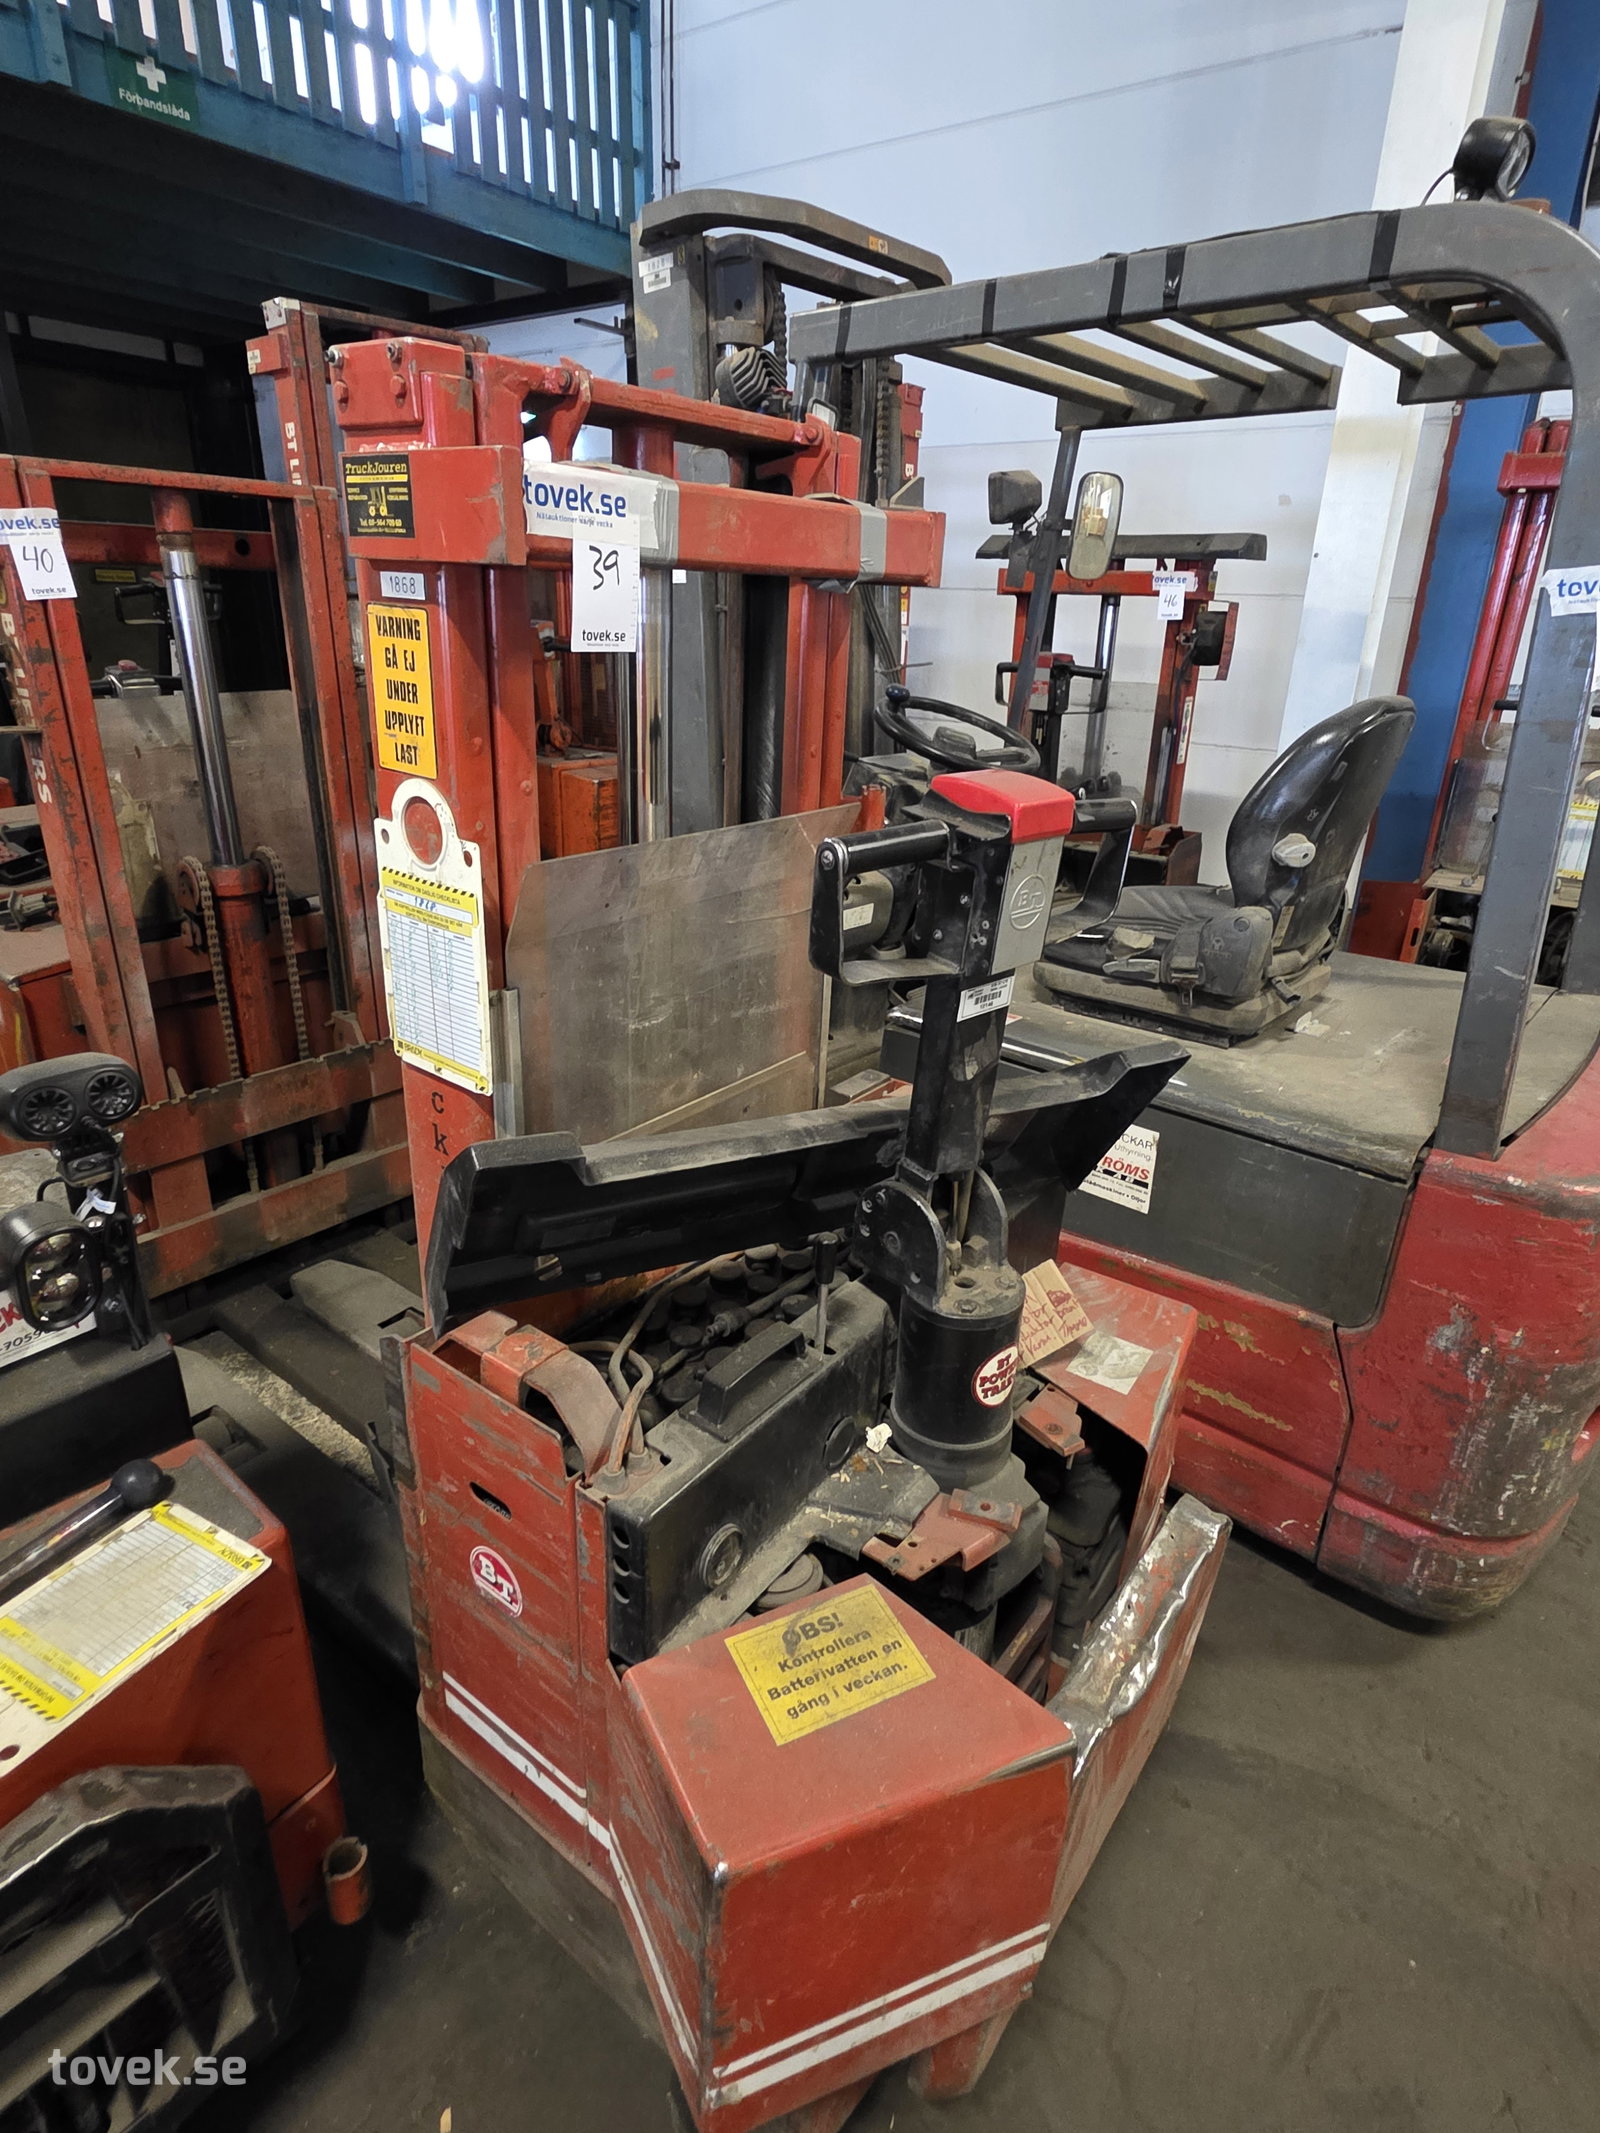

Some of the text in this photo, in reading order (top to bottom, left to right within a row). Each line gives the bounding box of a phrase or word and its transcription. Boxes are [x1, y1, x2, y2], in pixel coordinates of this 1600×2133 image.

[118, 87, 191, 121] Förbandslåda
[345, 461, 407, 474] TruckJouren
[523, 474, 627, 518] tovek.se
[22, 545, 54, 573] 40
[589, 545, 620, 590] 39
[389, 575, 417, 595] 1868
[1557, 578, 1600, 597] tov
[1164, 594, 1178, 608] 46
[375, 614, 421, 641] VARNING
[582, 629, 626, 642] tovek.se
[385, 643, 416, 672] GÅ EJ
[386, 678, 418, 704] UNDER
[384, 709, 425, 737] UPPLYFT
[394, 741, 418, 766] LAST
[1102, 1156, 1150, 1180] RÖMS
[997, 1353, 1012, 1371] BT
[479, 1553, 514, 1603] BT
[777, 1628, 872, 1674] Kontrollera
[766, 1638, 903, 1702] Batterivatten en
[786, 1693, 831, 1721] gång
[842, 1663, 909, 1694] veckan.
